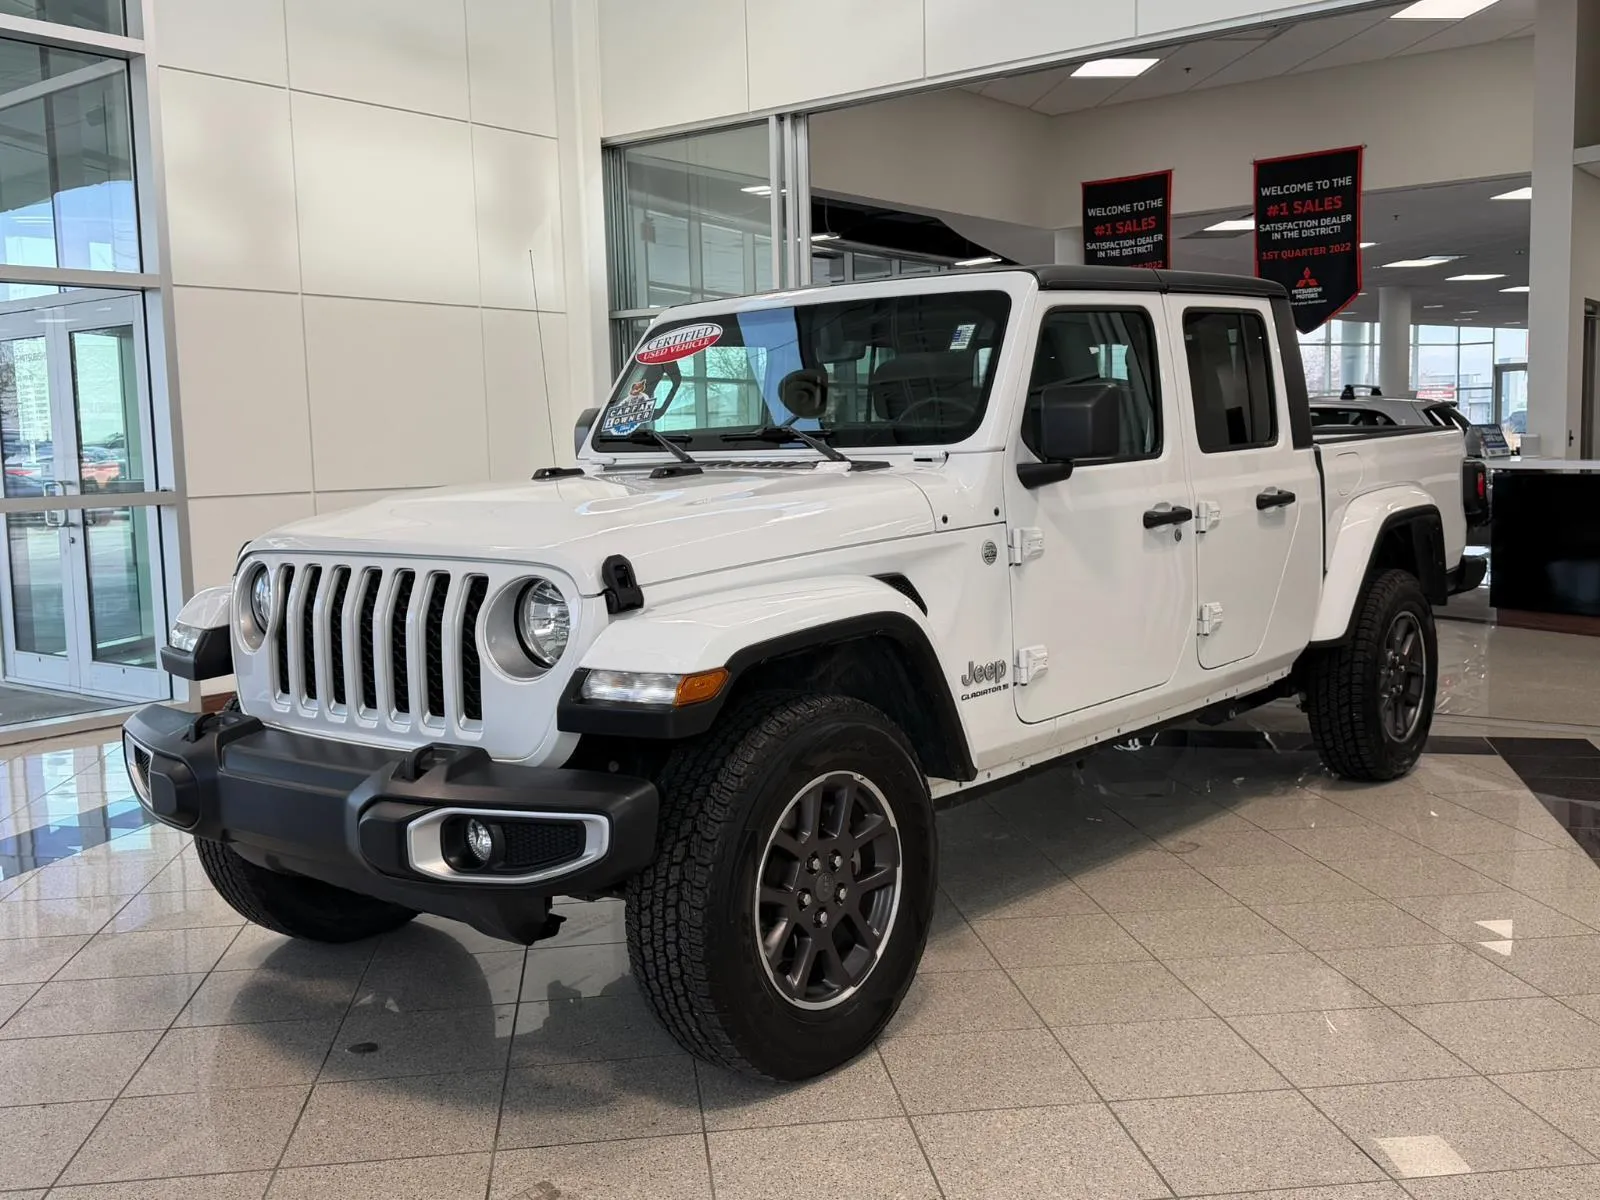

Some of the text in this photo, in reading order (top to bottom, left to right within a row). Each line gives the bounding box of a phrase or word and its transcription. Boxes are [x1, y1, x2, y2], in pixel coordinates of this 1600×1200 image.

[1261, 175, 1352, 196] WELCOME TO THE
[1087, 198, 1163, 217] WELCOME TO THE
[1266, 195, 1342, 217] #1 SALES
[1093, 216, 1156, 236] #1 SALES
[1259, 214, 1352, 232] SATISFACTION DEALER
[1086, 233, 1163, 250] SATISFACTION DEALER
[1271, 225, 1341, 240] IN THE DISTRICT!
[1097, 244, 1153, 258] IN THE DISTRICT!
[1262, 242, 1352, 260] 1ST QUARTER 2022
[1296, 292, 1318, 300] MOTORS
[647, 326, 714, 351] CERTIFIED
[643, 337, 711, 360] USED VEHICLE
[610, 402, 653, 417] CARFAX
[614, 412, 650, 425] OWNER
[961, 659, 1007, 687] Jeep
[961, 685, 1002, 701] GLADIATOR
